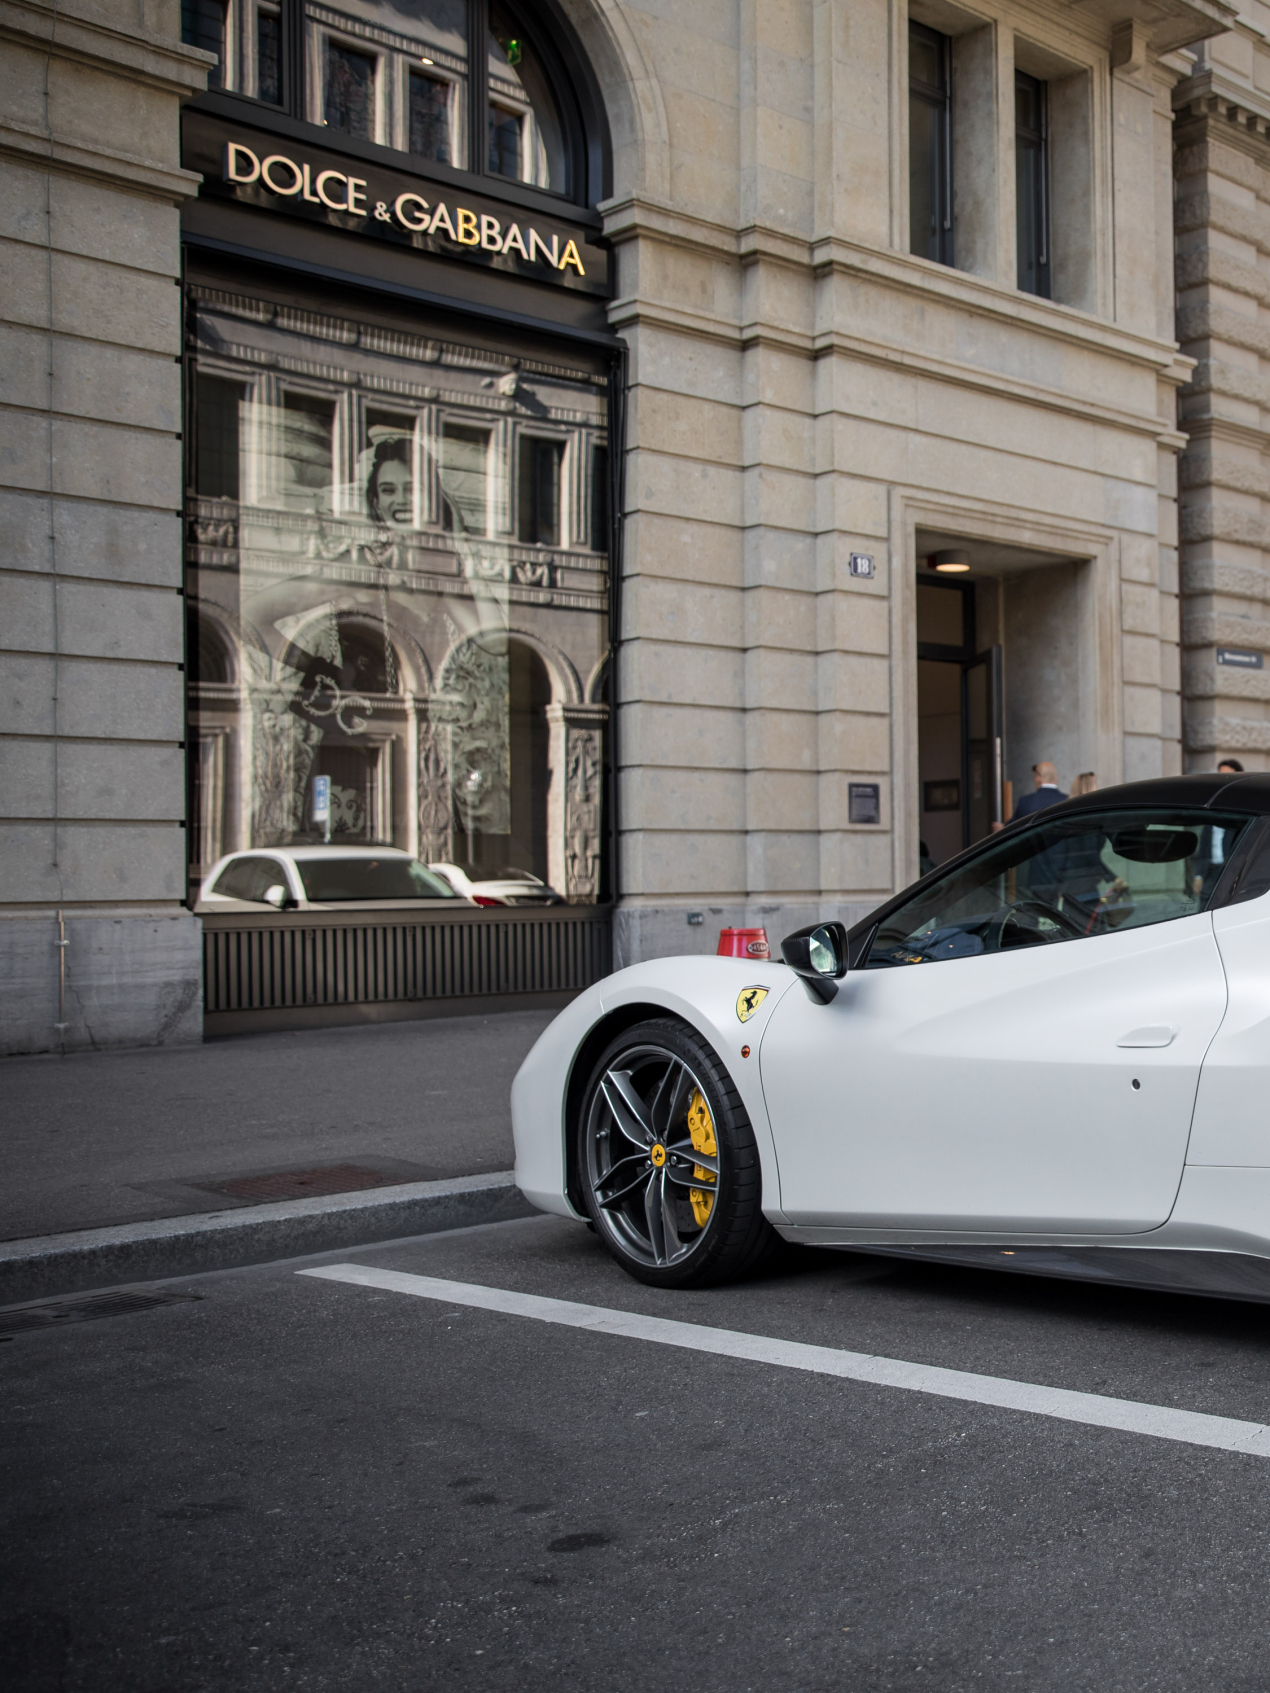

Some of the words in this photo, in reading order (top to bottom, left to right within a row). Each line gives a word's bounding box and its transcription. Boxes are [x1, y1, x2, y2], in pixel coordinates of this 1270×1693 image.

[224, 141, 367, 216] DOLCE
[374, 200, 391, 222] &
[395, 192, 586, 276] GABBANA
[856, 557, 869, 575] 18
